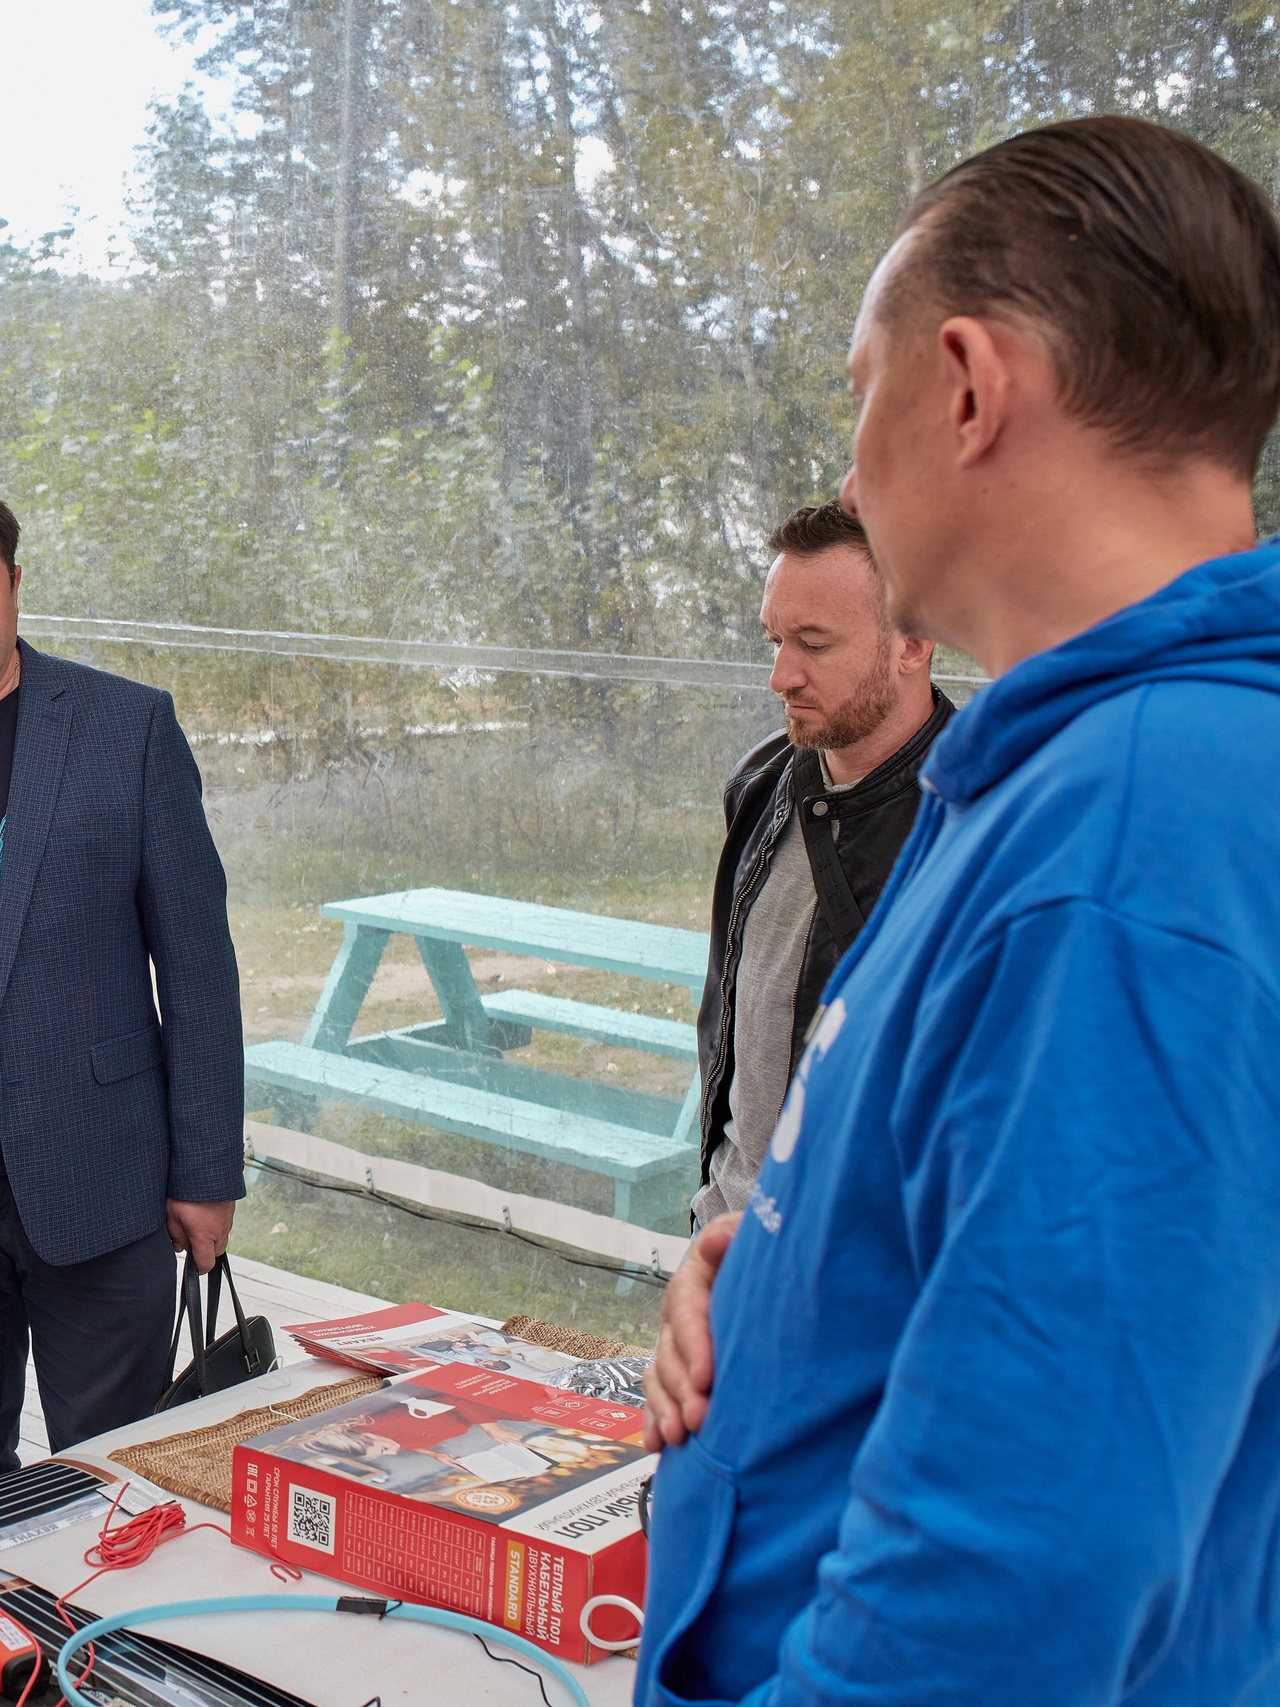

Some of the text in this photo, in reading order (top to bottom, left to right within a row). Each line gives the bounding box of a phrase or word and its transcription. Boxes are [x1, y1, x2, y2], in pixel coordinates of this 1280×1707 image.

[263, 1473, 271, 1511] ГАРАНТИЯ
[271, 1488, 279, 1522] СЛУЖБЫ
[263, 1512, 269, 1522] 25
[271, 1523, 277, 1533] 50
[553, 1514, 610, 1539] ПОЛ
[506, 1549, 520, 1620] STANDARD
[523, 1546, 539, 1636] ДВУХЖИЛЬНЫЙ
[535, 1551, 553, 1641] КАБЕЛЬНЫЙ
[549, 1554, 566, 1645] ТЕПЛЫЙ ПОЛ
